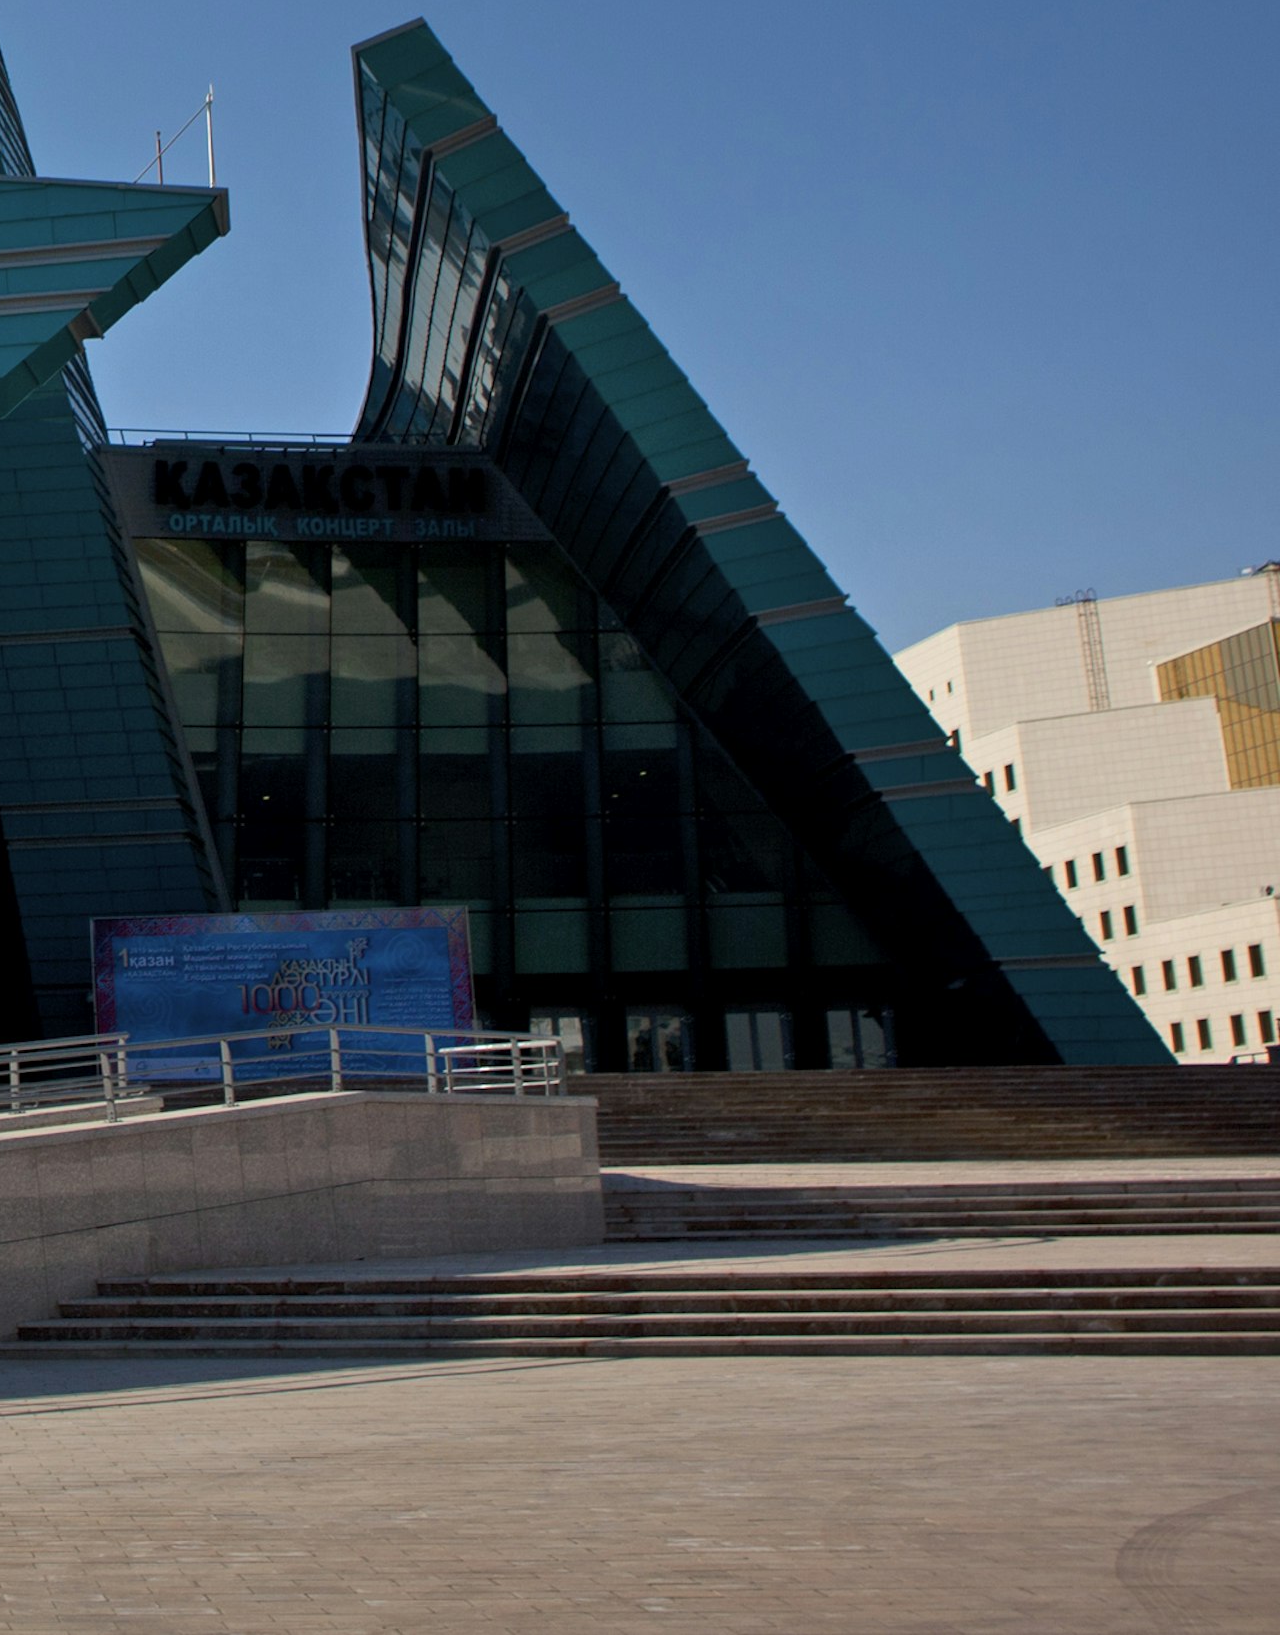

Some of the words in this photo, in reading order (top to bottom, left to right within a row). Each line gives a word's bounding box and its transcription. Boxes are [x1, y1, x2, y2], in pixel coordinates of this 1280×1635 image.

[153, 459, 489, 513] ҚАЗАҚСТАН
[168, 514, 277, 537] ОРТАЛЫҚ
[296, 518, 394, 539] КОНЦЕРТ
[414, 519, 476, 537] ЗАЛЫ
[118, 948, 129, 968] 1
[129, 955, 175, 970] қазан
[237, 982, 321, 1015] 1000
[311, 995, 369, 1025] ӘНІ
